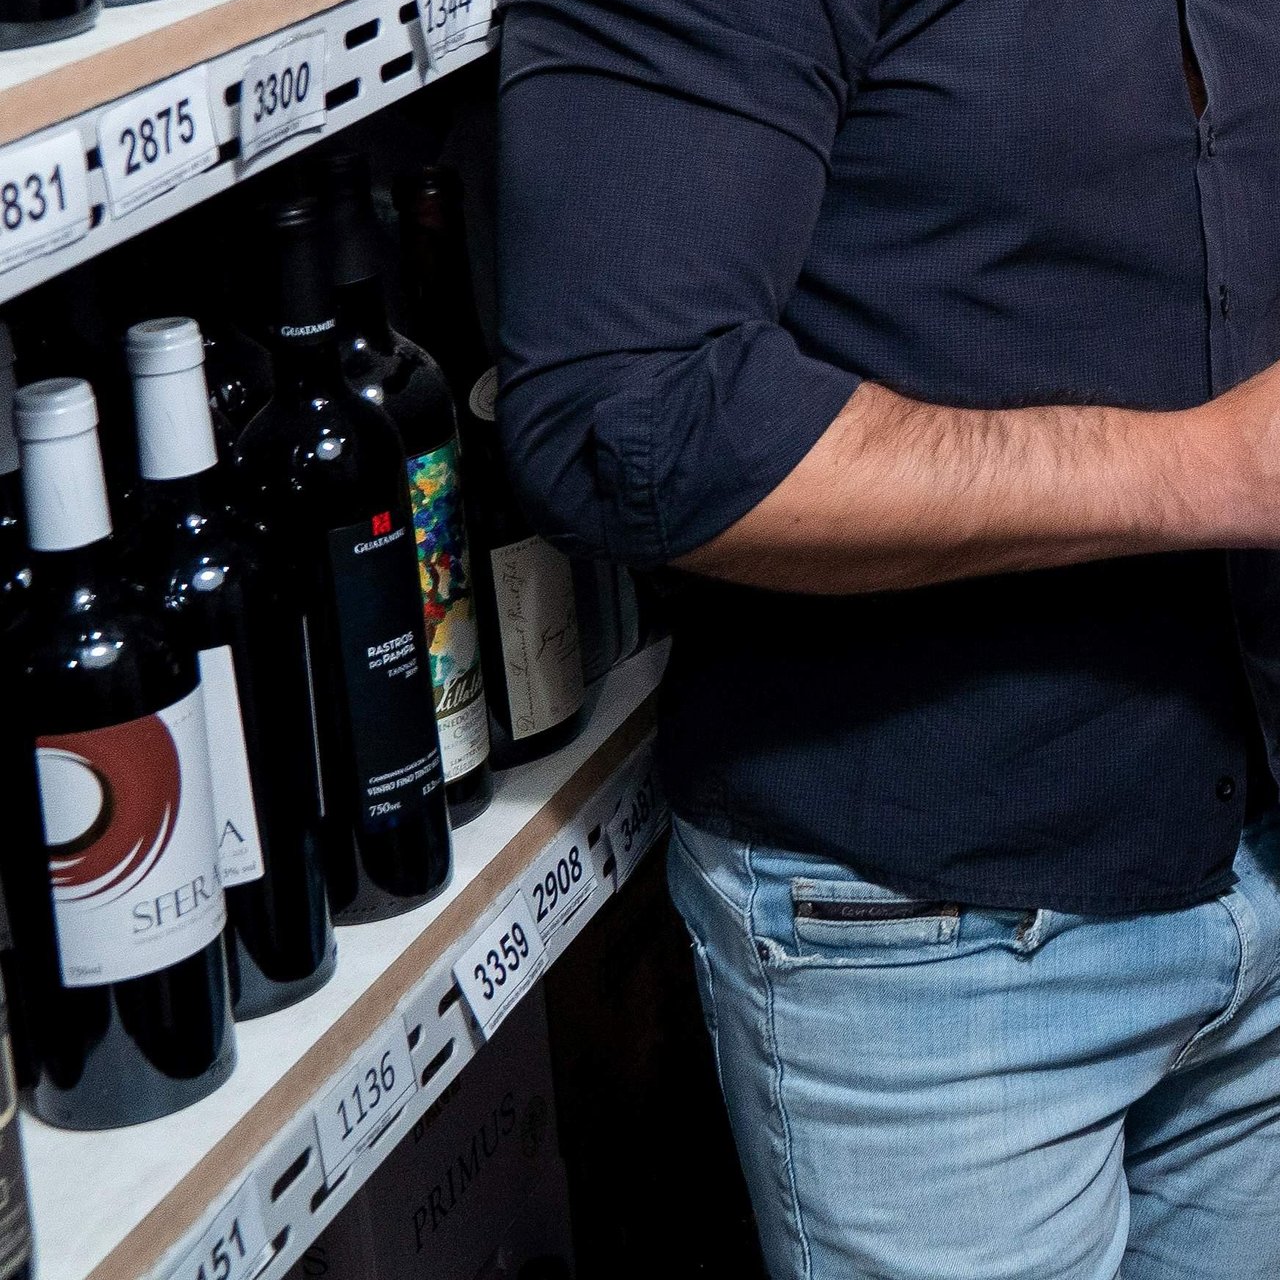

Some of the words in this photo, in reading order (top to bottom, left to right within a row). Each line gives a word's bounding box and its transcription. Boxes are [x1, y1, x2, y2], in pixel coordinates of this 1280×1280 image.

[252, 61, 310, 123] 3300
[118, 98, 196, 177] 2875
[0, 163, 66, 230] 831
[367, 630, 414, 658] RASTROS
[531, 845, 583, 923] 2908
[473, 922, 531, 1001] 3359
[336, 1050, 397, 1139] 1136
[409, 1090, 518, 1254] PRIMUS
